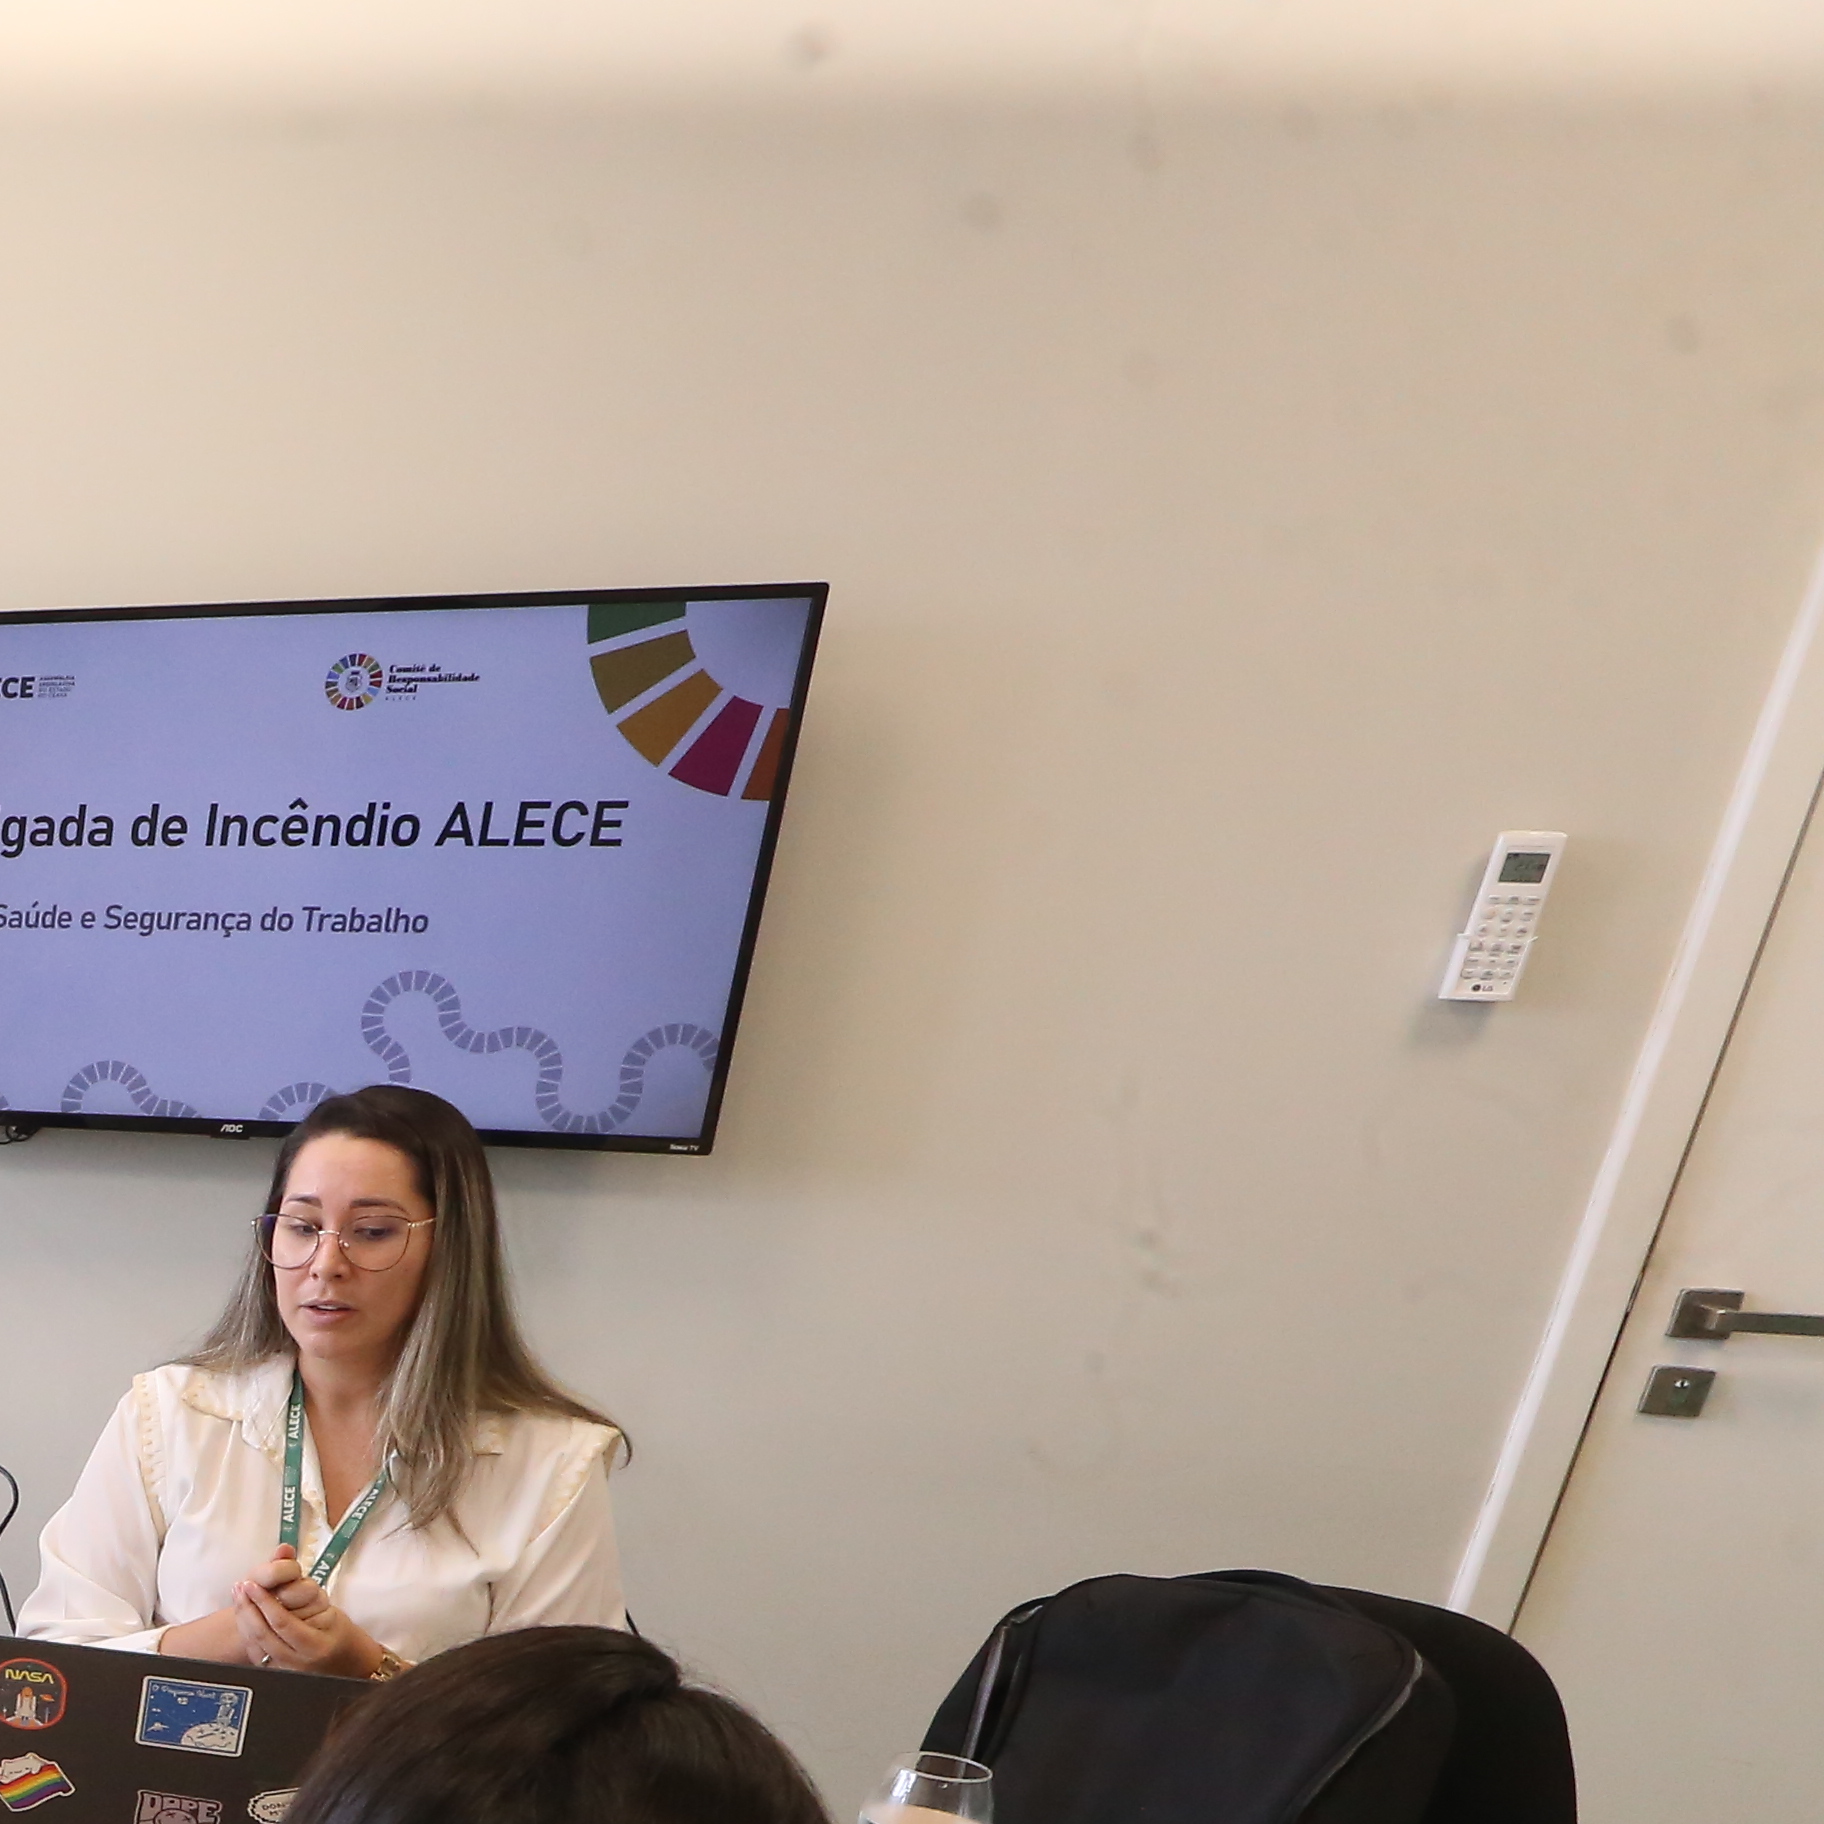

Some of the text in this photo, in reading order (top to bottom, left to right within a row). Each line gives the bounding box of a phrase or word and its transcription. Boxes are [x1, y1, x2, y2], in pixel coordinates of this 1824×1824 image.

[388, 673, 481, 685] Responsabilidade
[389, 663, 441, 673] Comitê de
[386, 684, 418, 694] Social
[131, 803, 189, 847] de
[204, 797, 421, 847] Incêndio
[434, 800, 630, 848] ALECE
[80, 911, 96, 929] e
[104, 904, 251, 937] Segurança
[260, 906, 294, 932] do
[302, 906, 430, 933] Trabalho
[288, 1403, 301, 1440] ALECE
[283, 1486, 296, 1523] ALECE
[351, 1488, 379, 1520] ALECE
[5, 1668, 54, 1684] NASA
[140, 1791, 220, 1824] DOPE
